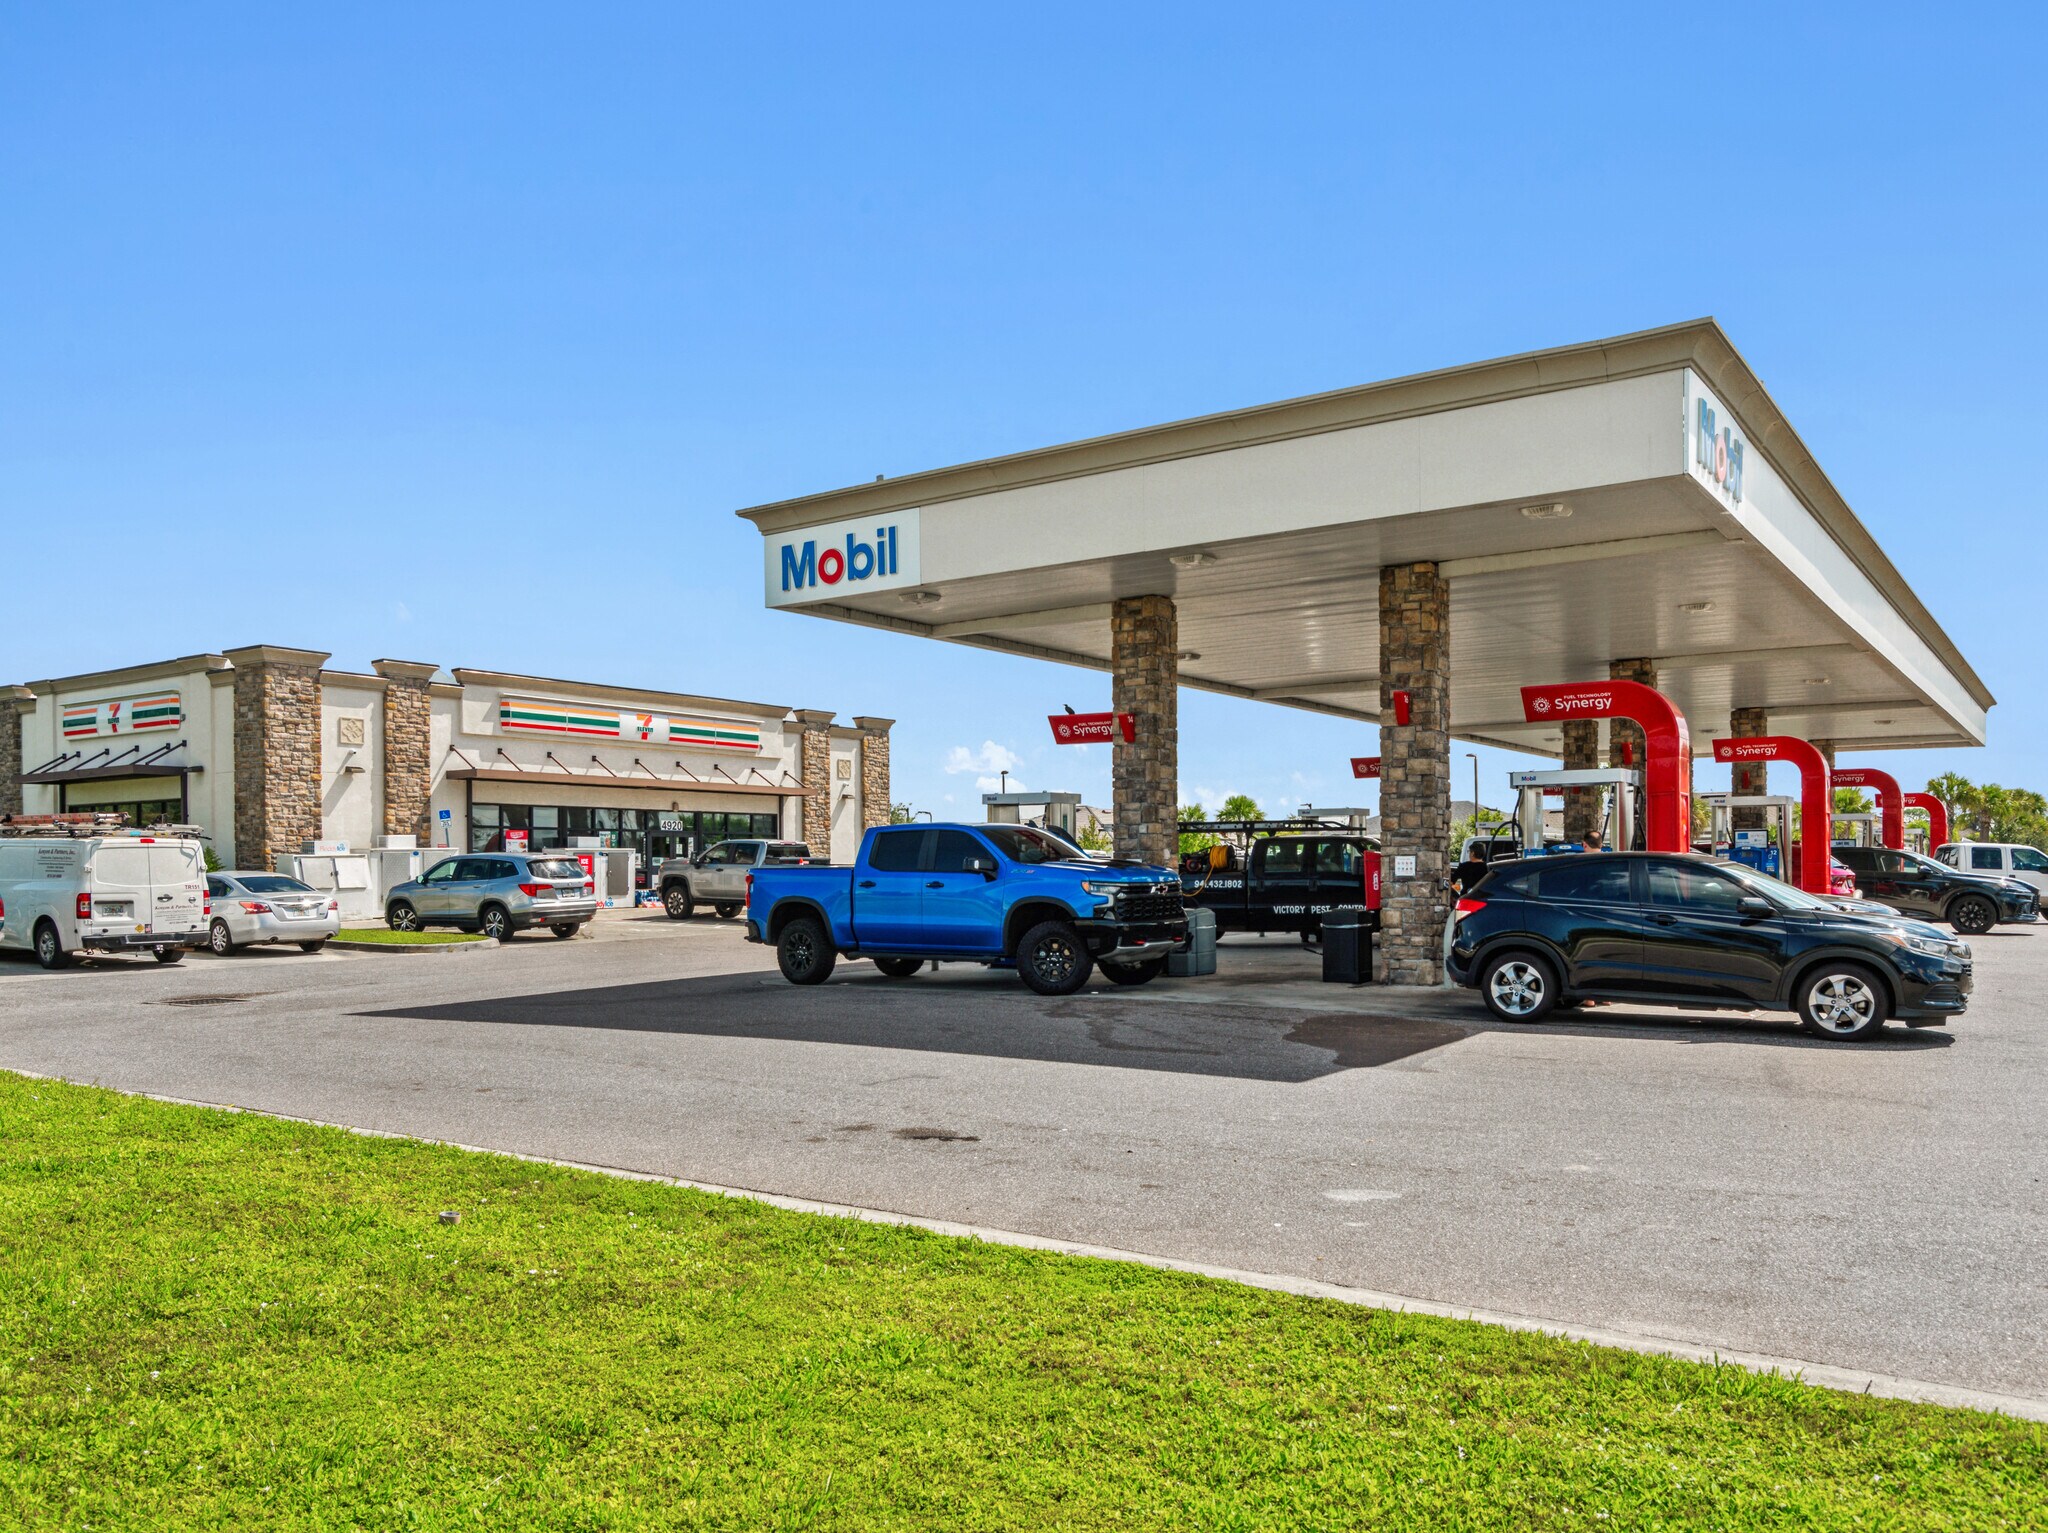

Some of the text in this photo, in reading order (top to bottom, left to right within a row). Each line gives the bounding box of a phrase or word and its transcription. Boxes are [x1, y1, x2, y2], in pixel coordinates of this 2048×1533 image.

[1697, 397, 1743, 504] Mobil
[781, 525, 898, 592] Mobil
[1554, 697, 1612, 712] Synergy
[1072, 724, 1113, 737] Synergy
[1736, 746, 1777, 756] Synergy
[1832, 775, 1865, 783] Synergy
[661, 820, 682, 830] 4920
[1273, 905, 1305, 914] VICTORY
[1311, 905, 1331, 914] PEST
